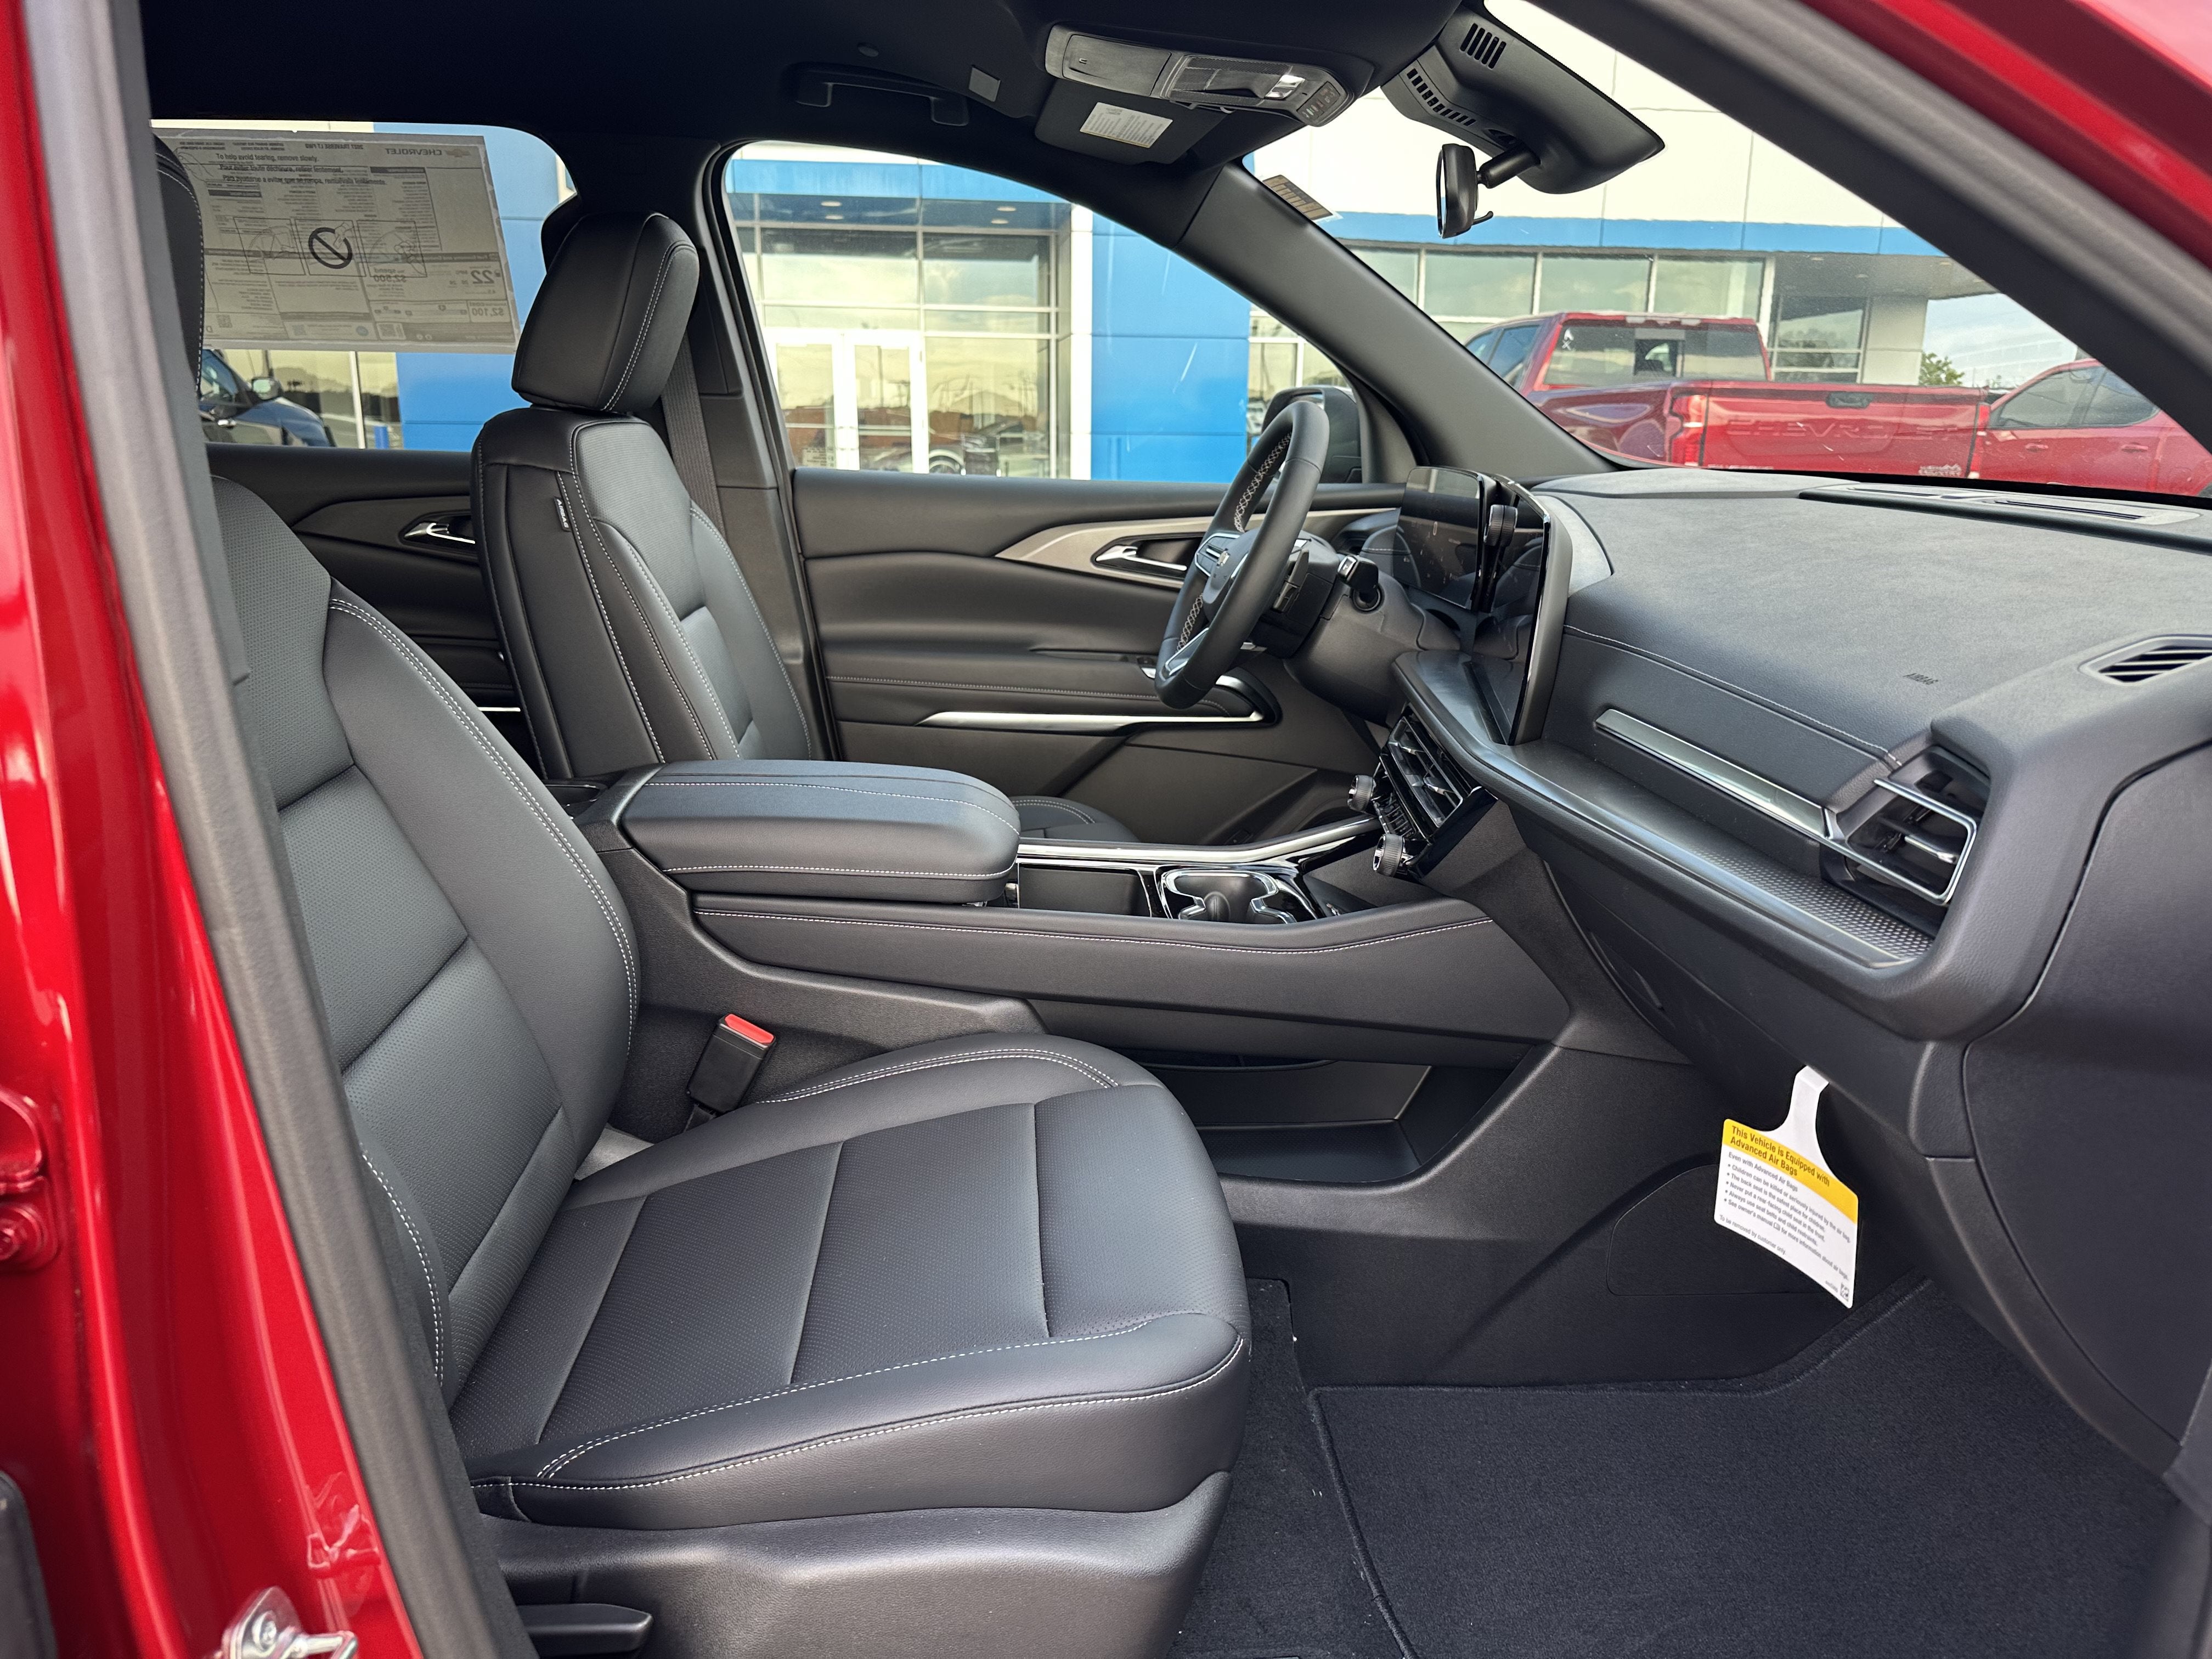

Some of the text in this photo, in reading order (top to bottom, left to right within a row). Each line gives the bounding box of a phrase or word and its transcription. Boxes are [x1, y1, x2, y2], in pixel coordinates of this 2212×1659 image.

[556, 499, 569, 528] AIRBAG
[1902, 673, 1939, 685] AIRBAG
[1729, 1152, 1741, 1162] Even
[1742, 1158, 1753, 1167] with
[1754, 1164, 1778, 1180] Advanced
[1786, 1180, 1798, 1192] Bags
[1730, 1136, 1798, 1176] Advanced Air Bags
[1732, 1126, 1830, 1187] This Vehicle is Equipped with
[1730, 1182, 1743, 1192] Never
[1745, 1189, 1753, 1198] put
[1757, 1195, 1781, 1213] rear-facing
[1782, 1209, 1792, 1219] child
[1793, 1216, 1802, 1226] seat
[1731, 1173, 1740, 1182] The
[1741, 1177, 1752, 1187] back
[1753, 1184, 1763, 1193] seat
[1776, 1197, 1790, 1207] safest
[1790, 1205, 1802, 1215] place
[1732, 1165, 1752, 1178] Children
[1763, 1179, 1769, 1187] be
[1770, 1182, 1783, 1194] killed
[1789, 1194, 1809, 1211] seriously
[1728, 1199, 1737, 1208] See
[1737, 1205, 1756, 1217] owner's
[1757, 1214, 1773, 1227] manual
[1788, 1232, 1799, 1243] more
[1729, 1190, 1746, 1203] Always
[1756, 1204, 1765, 1213] seat
[1766, 1210, 1777, 1220] belts
[1778, 1217, 1786, 1225] and
[1786, 1222, 1797, 1232] child
[1732, 1221, 1751, 1234] removed
[1751, 1230, 1757, 1238] by
[1757, 1233, 1776, 1249] customer
